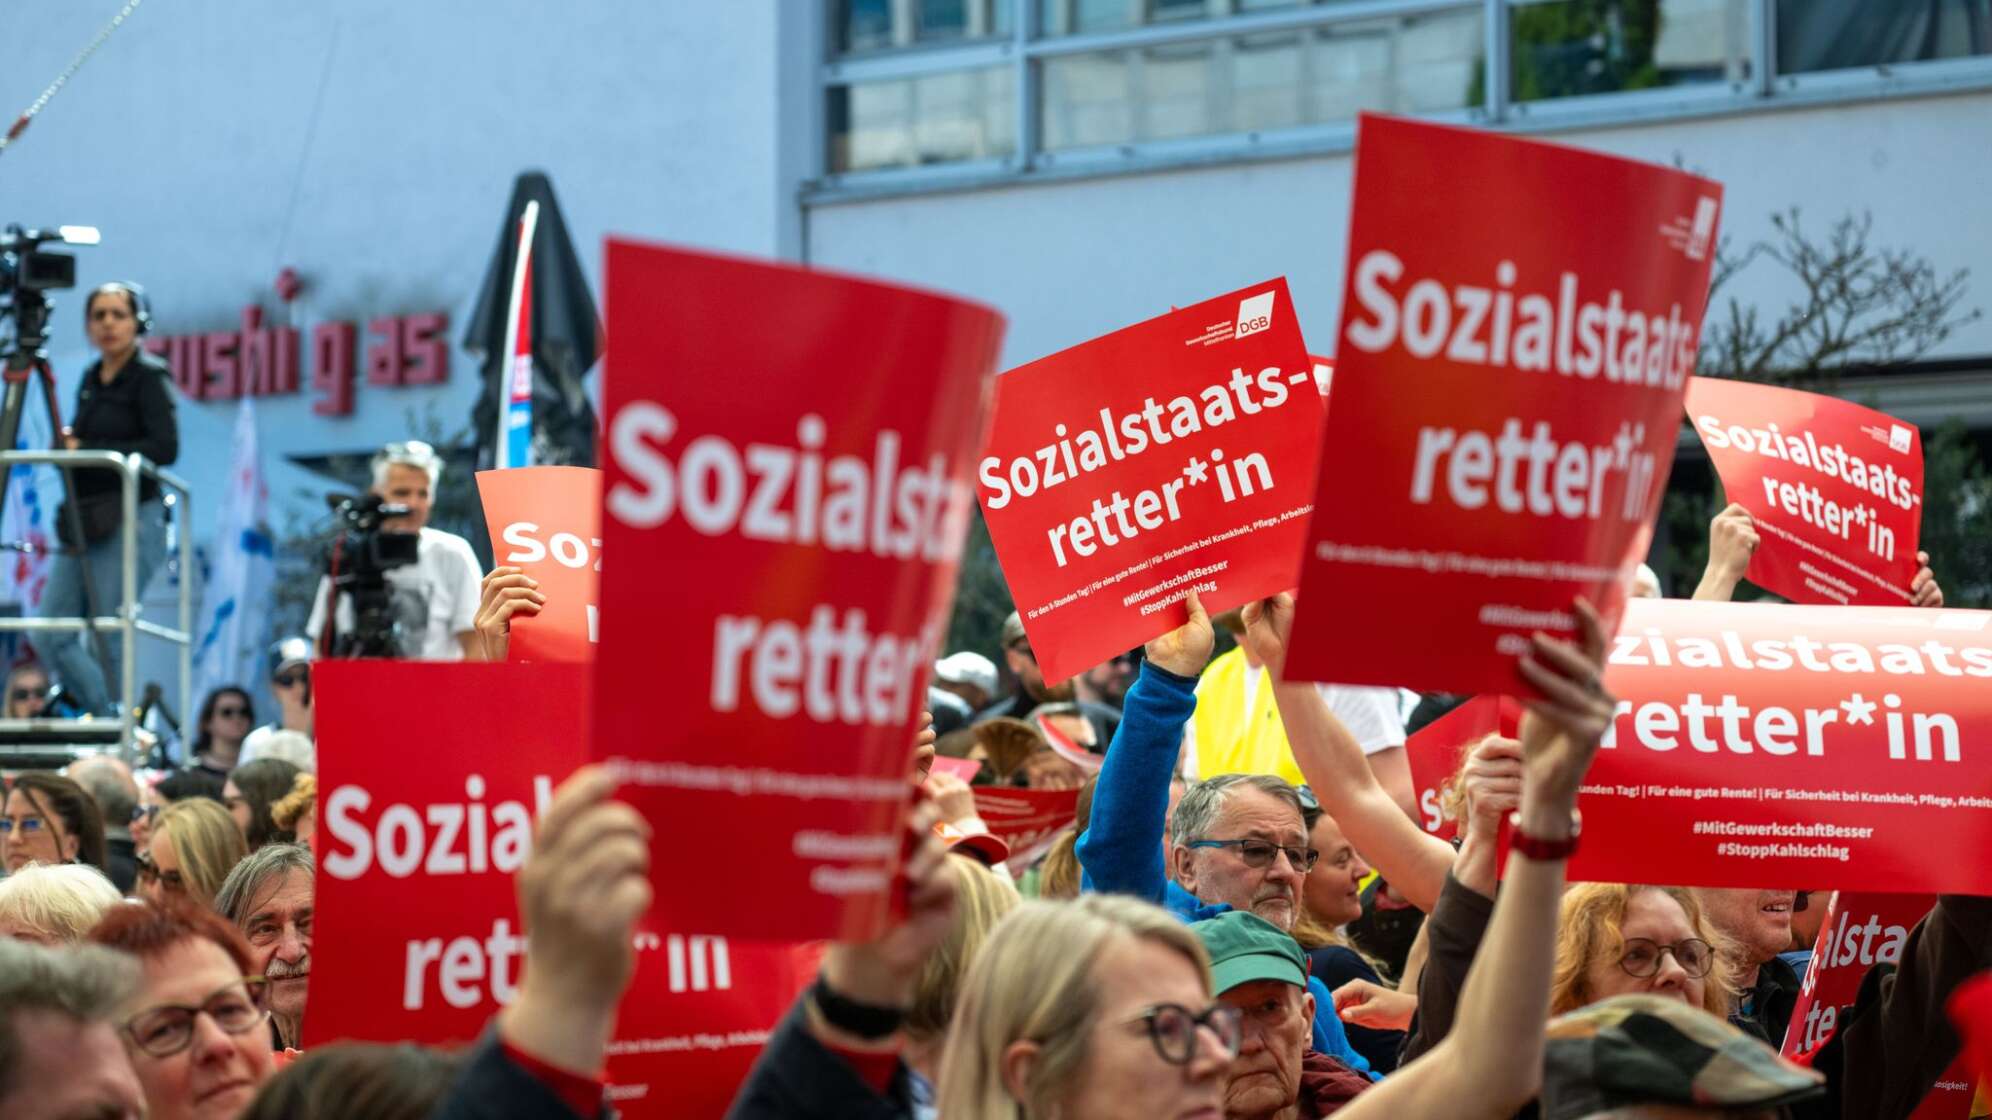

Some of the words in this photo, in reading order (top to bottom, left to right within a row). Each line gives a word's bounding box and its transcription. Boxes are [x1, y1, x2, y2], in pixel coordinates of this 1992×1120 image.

[1239, 316, 1269, 334] DGB
[1346, 250, 1695, 390] Sozialstaats-
[979, 365, 1309, 510] Sozialstaats-
[1698, 415, 1921, 510] Sozialstaats-
[1163, 542, 1200, 561] Sicherheit
[1212, 525, 1254, 544] Krankheit,
[1123, 560, 1229, 607] #MitGewerkschaftBesser
[1608, 629, 1992, 678] zialstaats
[1616, 785, 1640, 798] Tag!
[1648, 785, 1667, 796] Für
[1668, 786, 1692, 798] eine
[1694, 787, 1719, 800] gute
[1720, 787, 1757, 799] Rente!
[1764, 788, 1784, 799] Für
[1785, 789, 1841, 801] Sicherheit
[1842, 790, 1860, 802] bei
[1861, 791, 1919, 806] Krankheit,
[1919, 794, 1957, 809] Pflege,
[1693, 820, 1874, 839] #MitGewerkschaftBesser
[1717, 842, 1850, 862] #StoppKahlschlag
